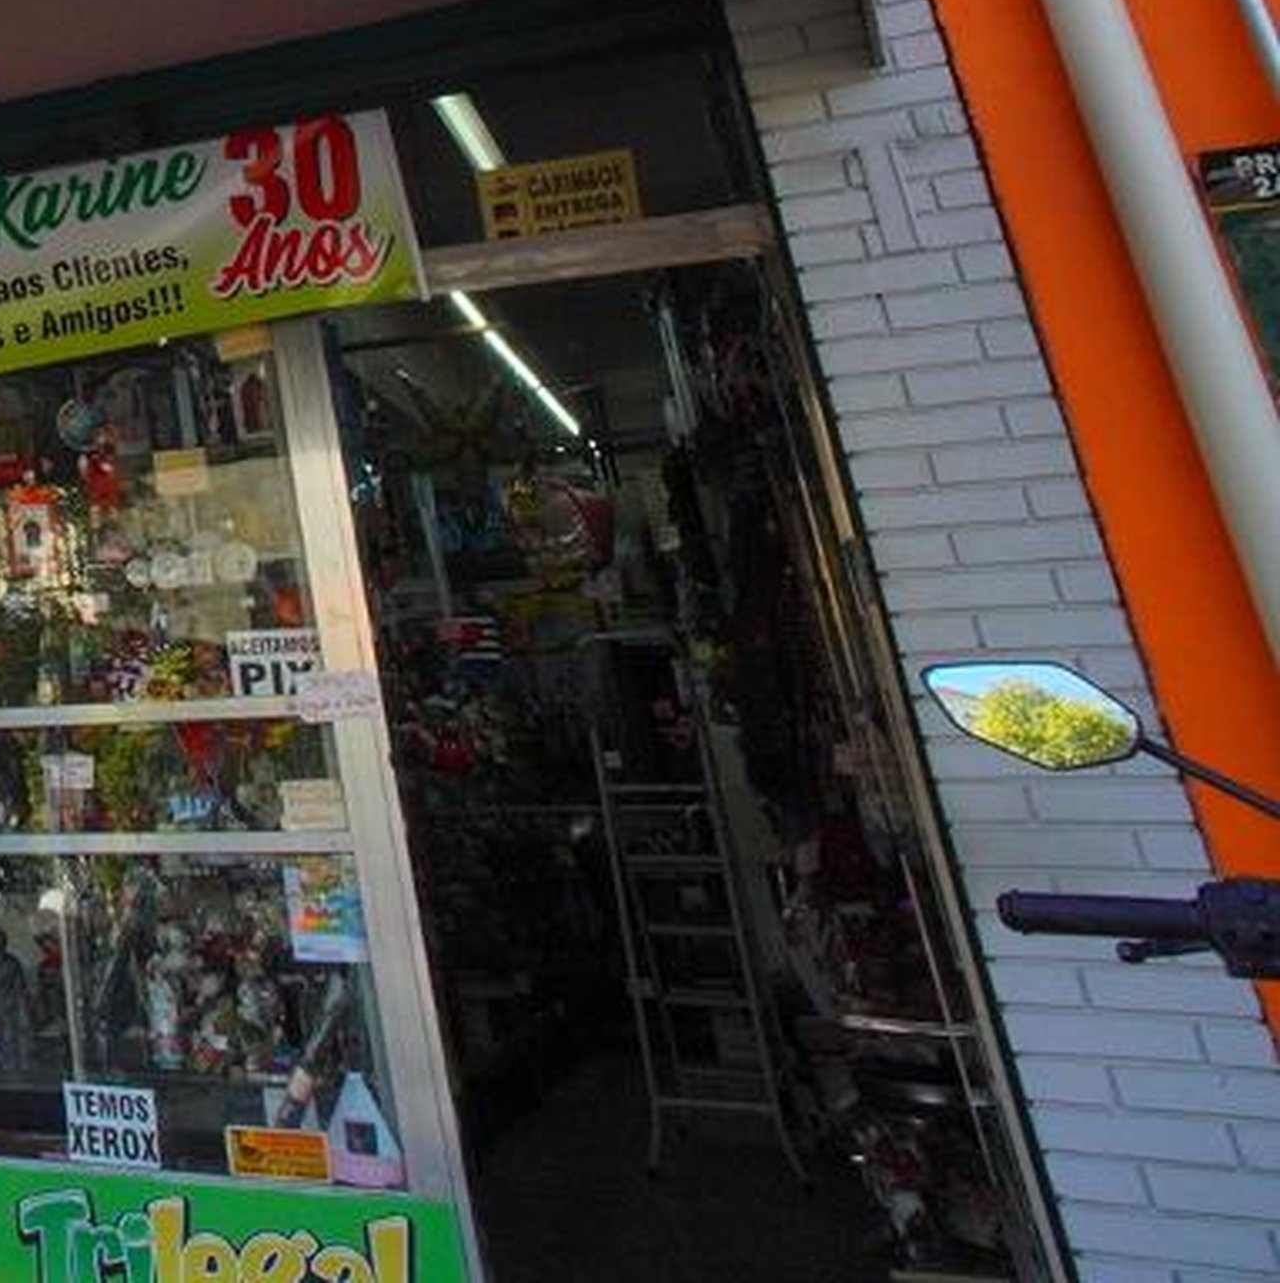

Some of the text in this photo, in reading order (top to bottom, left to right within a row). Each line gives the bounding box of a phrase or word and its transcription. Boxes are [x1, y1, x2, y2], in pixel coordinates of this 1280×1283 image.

[223, 112, 360, 228] 30
[51, 242, 191, 294] Clientes,
[208, 214, 394, 298] Anos
[14, 321, 32, 345] e
[40, 283, 186, 341] Amigos!!!
[230, 634, 322, 656] ACEITAMOS
[71, 1088, 149, 1122] TEMOS
[69, 1121, 158, 1162] XEROX
